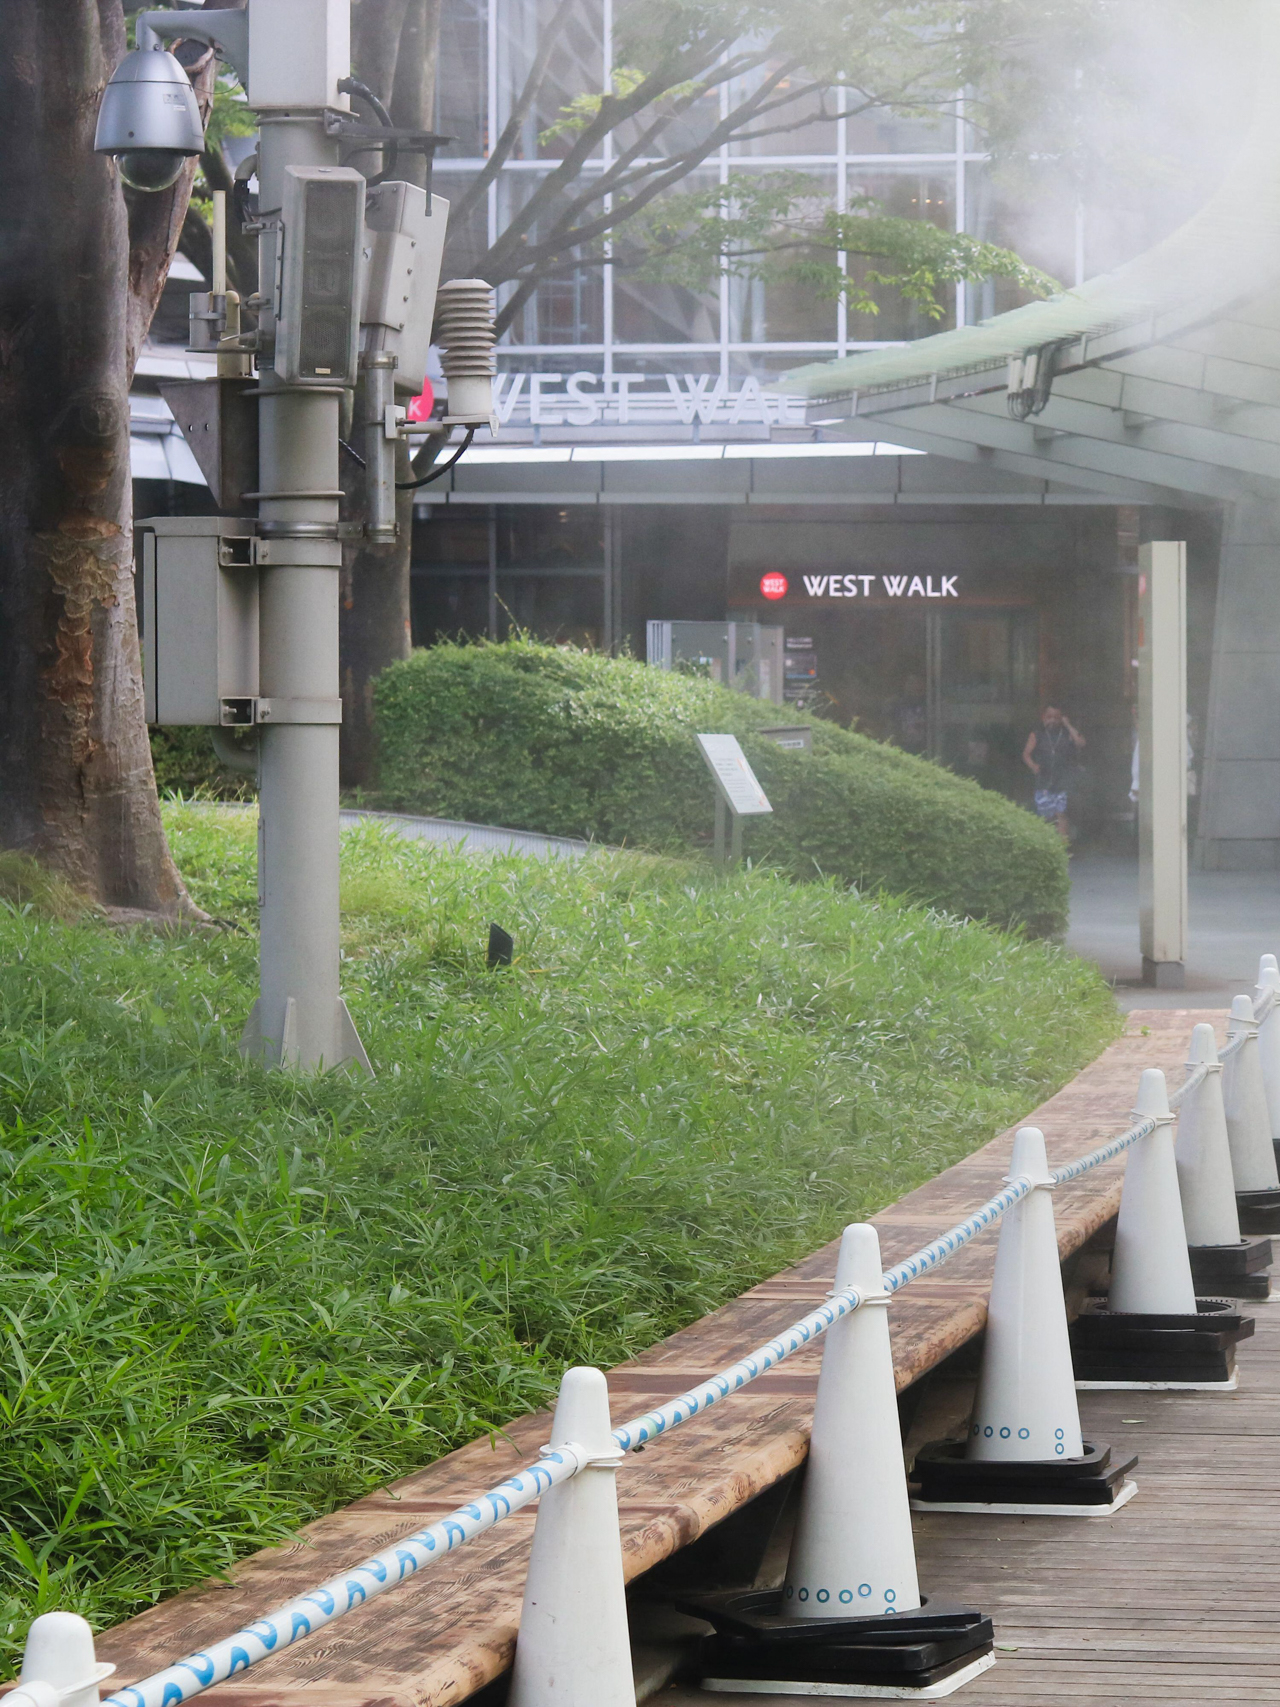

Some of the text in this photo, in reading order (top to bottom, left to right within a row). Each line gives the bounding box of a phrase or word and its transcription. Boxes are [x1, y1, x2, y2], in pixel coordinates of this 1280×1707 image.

[665, 373, 806, 425] WAL
[803, 575, 959, 597] WEST WALK
